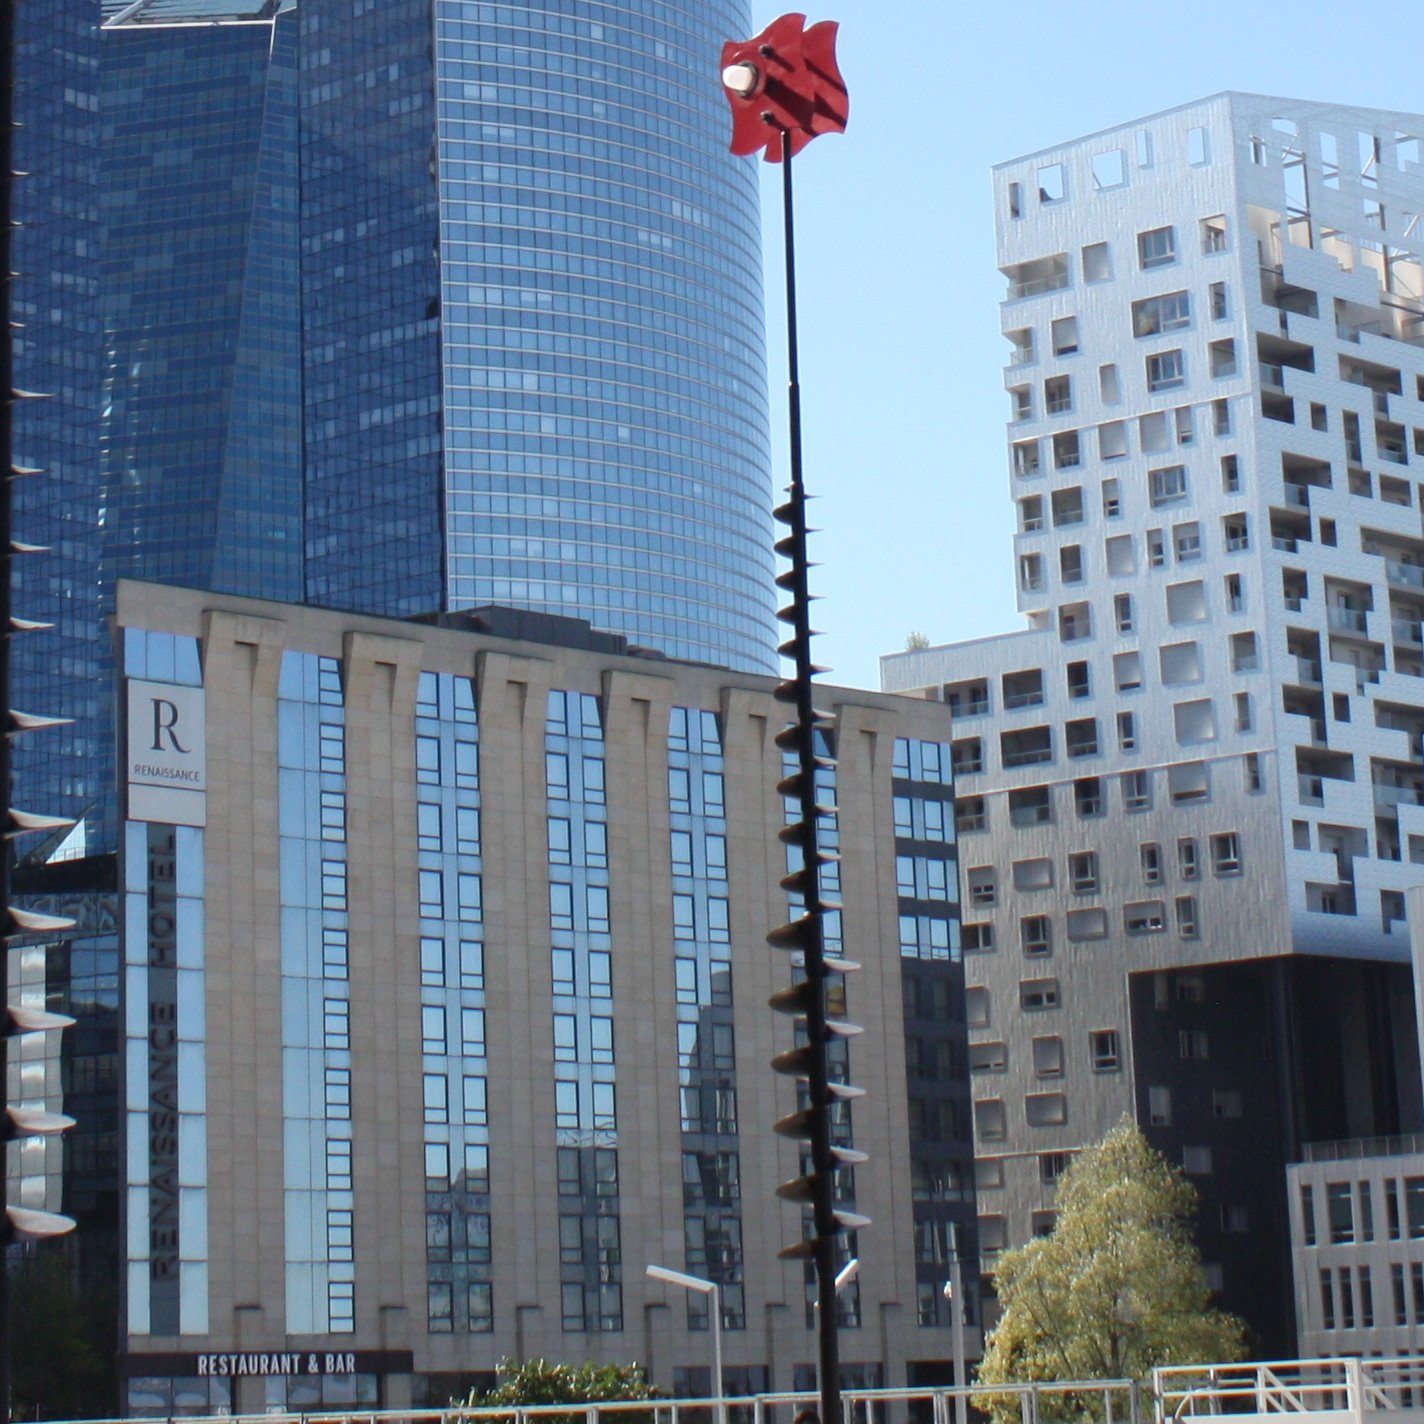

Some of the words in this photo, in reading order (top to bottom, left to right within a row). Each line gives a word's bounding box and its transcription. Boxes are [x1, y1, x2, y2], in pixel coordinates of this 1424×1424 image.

[150, 697, 192, 754] R
[134, 763, 201, 782] RENAISSANCE
[149, 833, 175, 968] HOTEL
[150, 1001, 177, 1279] RENAISSANCE
[197, 1353, 301, 1375] RESTAURANT
[307, 1353, 320, 1374] &
[325, 1352, 356, 1373] BAR
